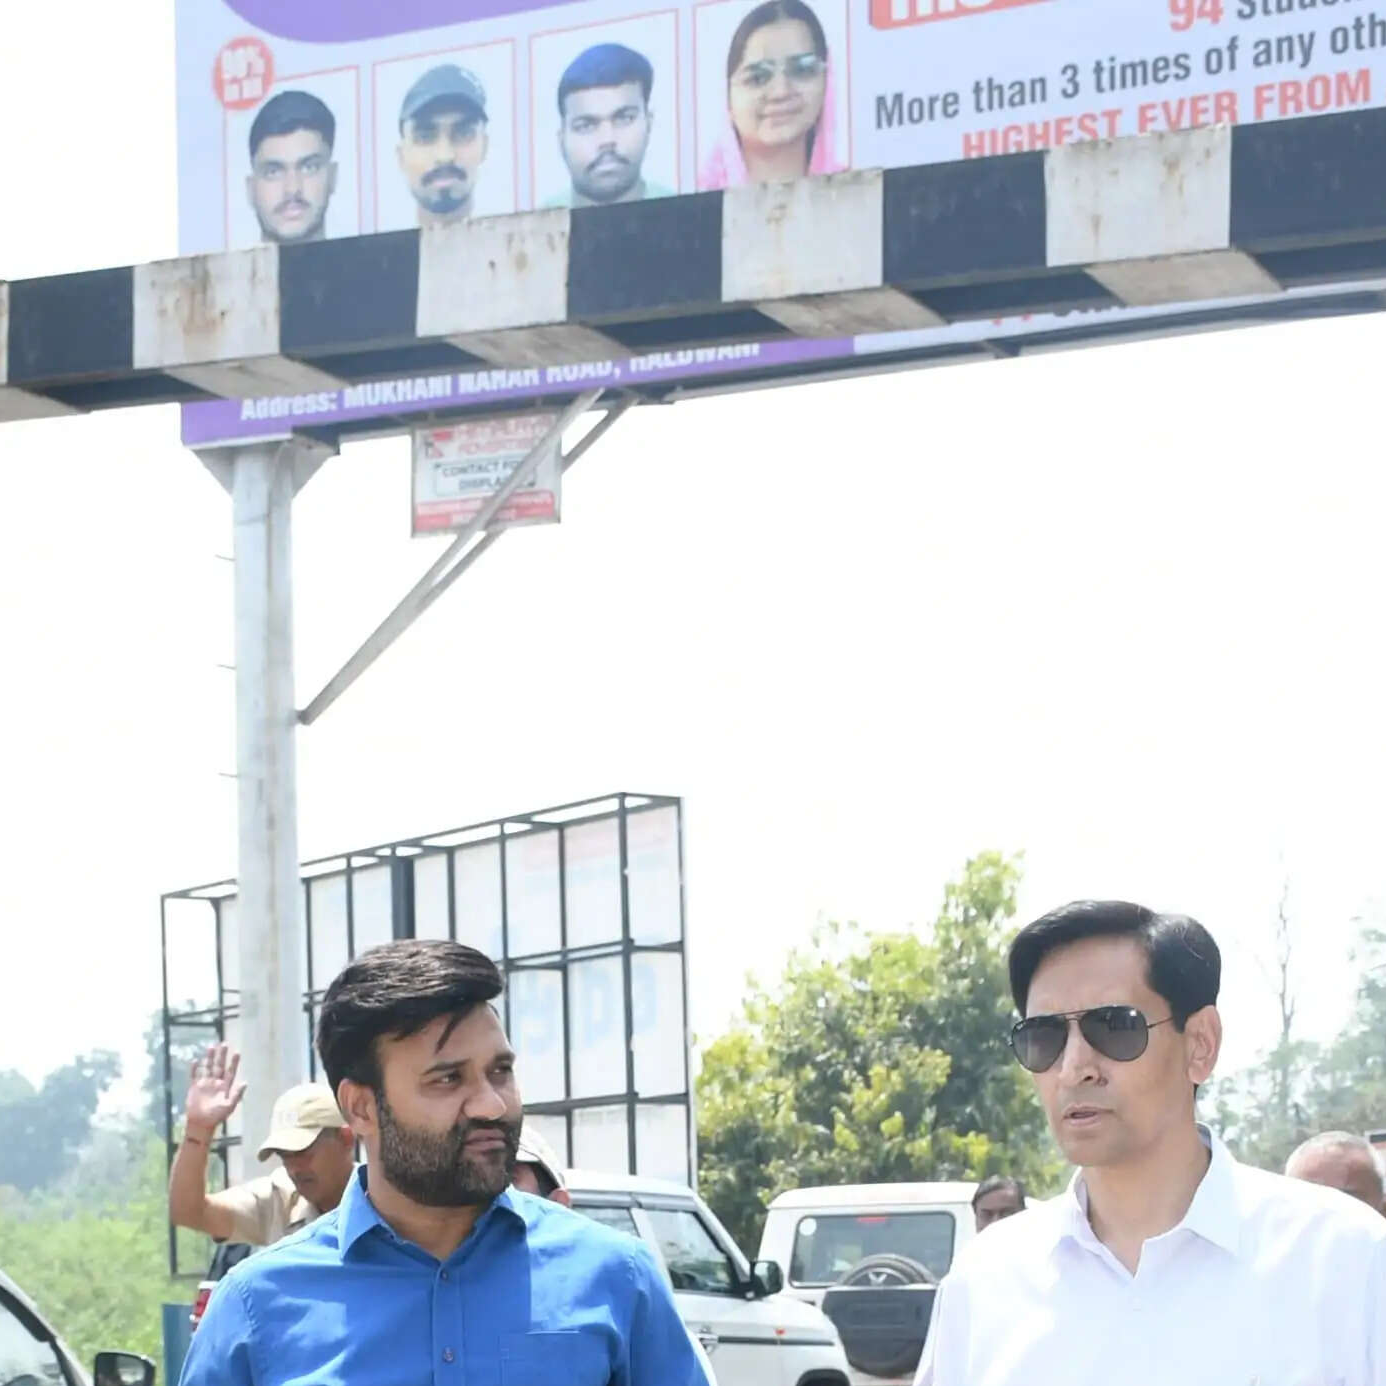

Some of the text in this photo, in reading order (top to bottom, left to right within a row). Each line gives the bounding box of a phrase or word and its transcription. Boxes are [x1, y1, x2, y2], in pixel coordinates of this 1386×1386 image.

[1169, 0, 1223, 32] 94
[875, 92, 960, 130] More
[973, 74, 1048, 114] than
[1061, 64, 1081, 100] 3
[1093, 52, 1191, 94] times
[1205, 35, 1240, 75] of
[1253, 29, 1316, 70] any
[962, 109, 1124, 159] HIGHEST
[1138, 90, 1239, 134] EVER
[1254, 62, 1371, 120] FROM
[241, 392, 338, 421] Address:
[343, 375, 452, 409] MUKHANI
[459, 476, 505, 491] DISPLA
